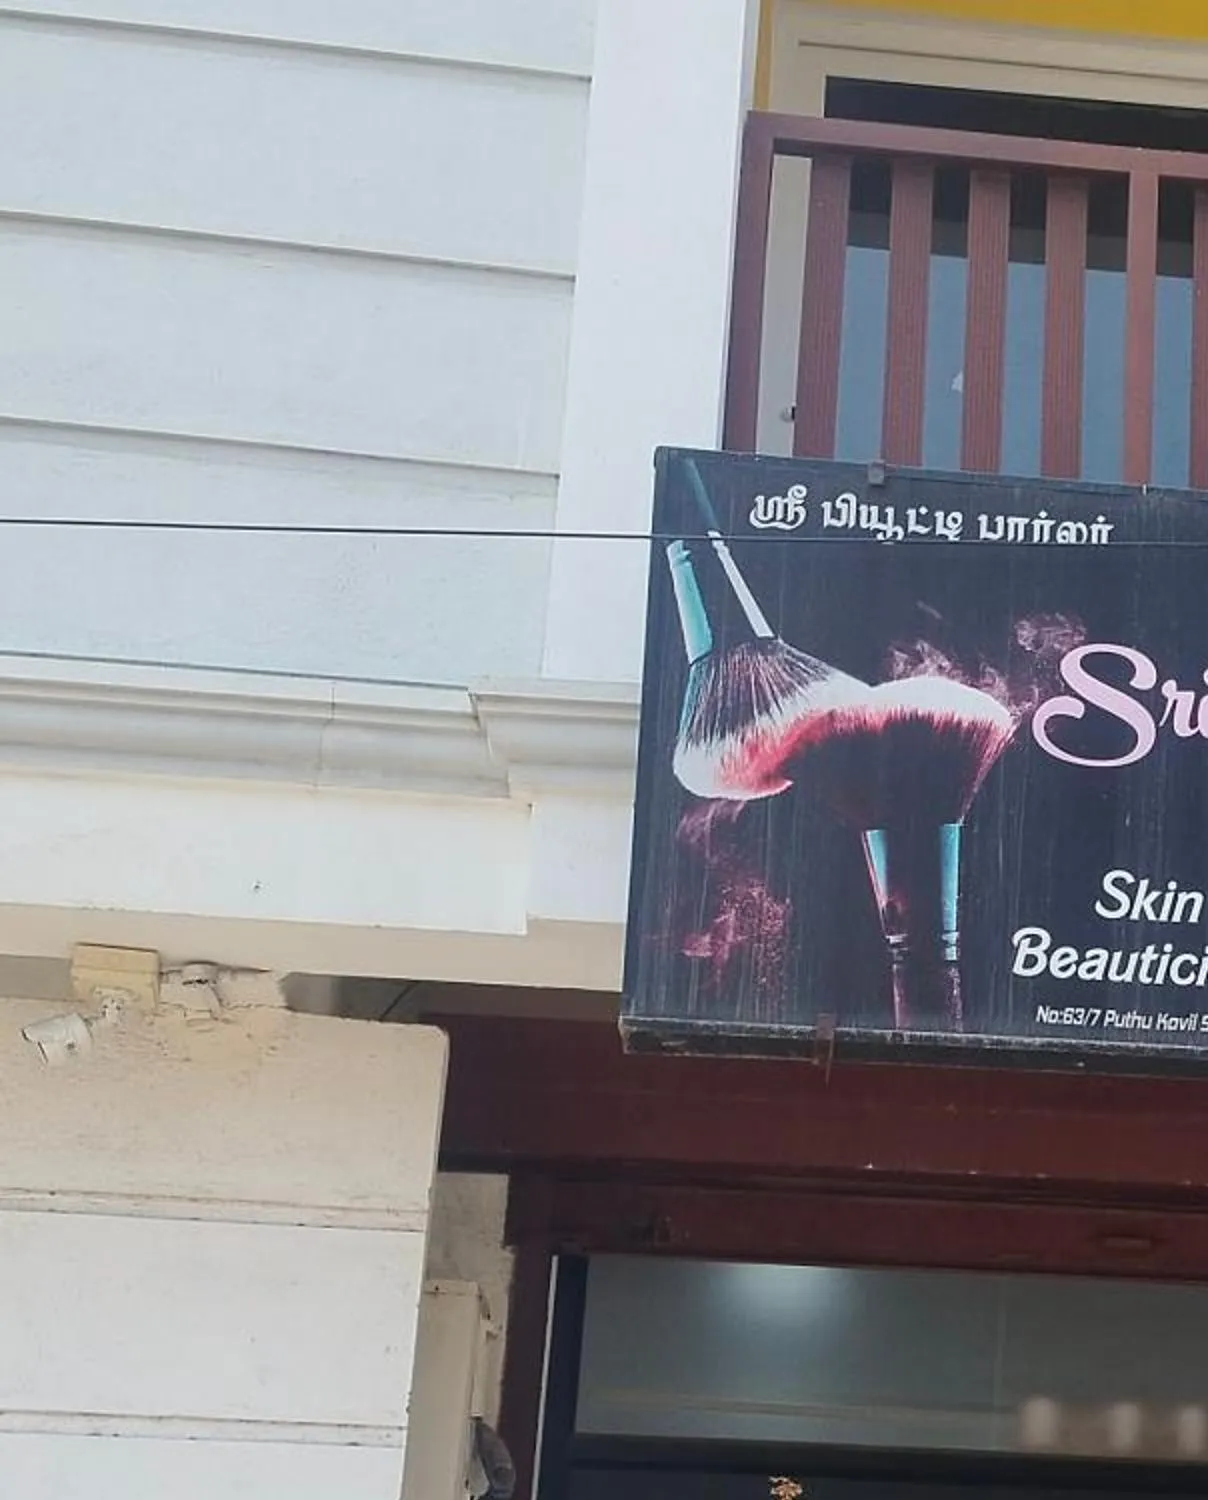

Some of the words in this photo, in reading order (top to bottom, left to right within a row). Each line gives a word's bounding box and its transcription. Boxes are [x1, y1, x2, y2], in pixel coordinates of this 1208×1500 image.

[978, 509, 1114, 544] பார்லர்
[1095, 869, 1204, 923] Skin
[1036, 1005, 1101, 1027] No:63/7
[1104, 1009, 1153, 1030] Puthu
[1156, 1012, 1199, 1033] Kovil
